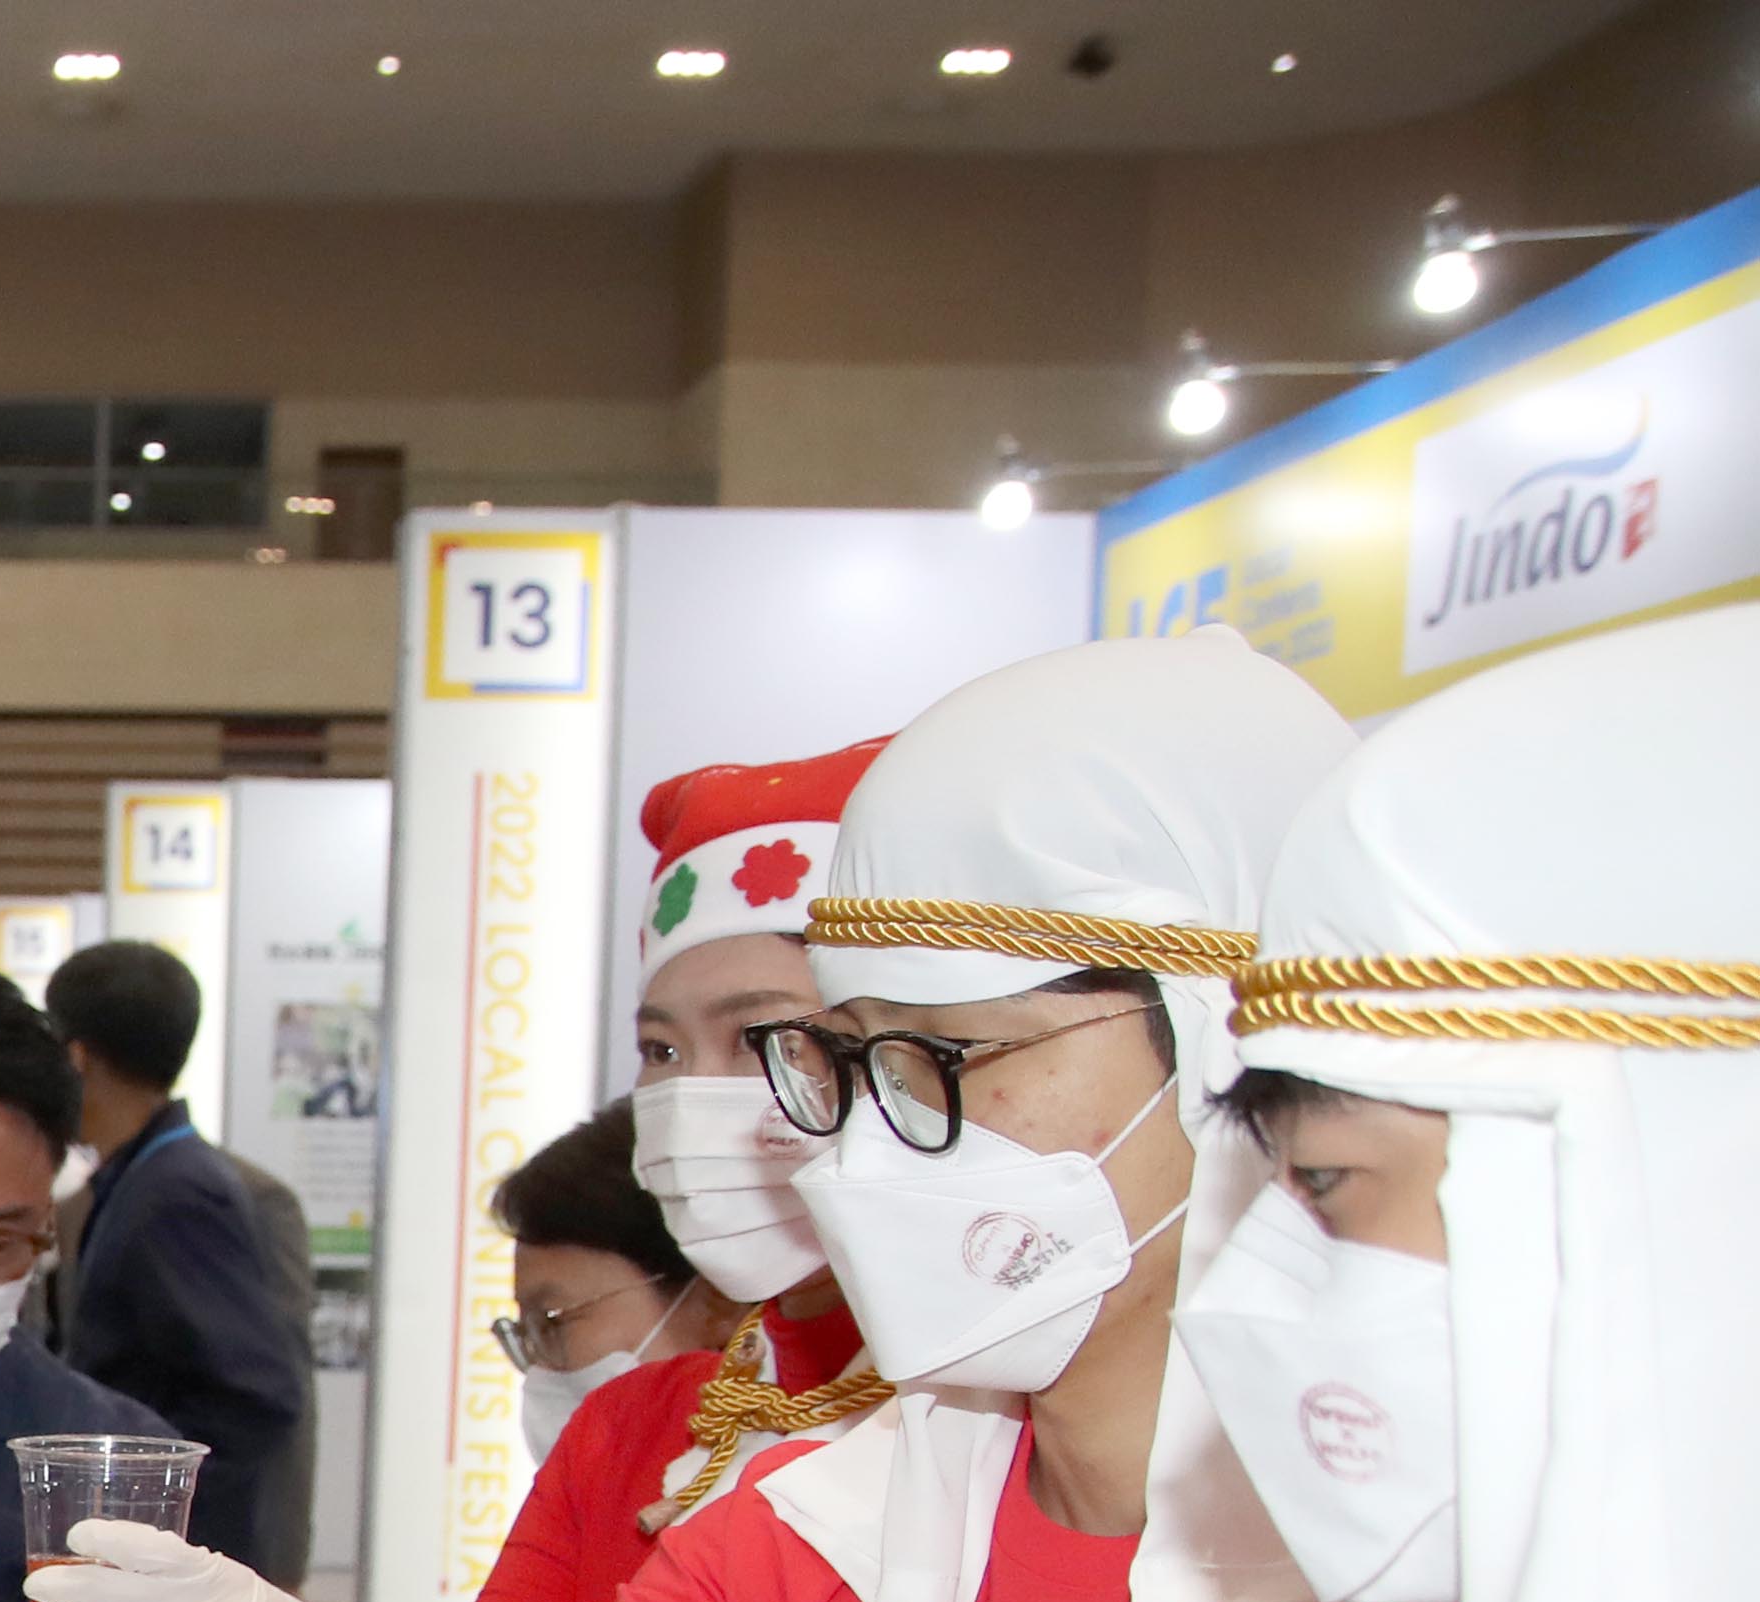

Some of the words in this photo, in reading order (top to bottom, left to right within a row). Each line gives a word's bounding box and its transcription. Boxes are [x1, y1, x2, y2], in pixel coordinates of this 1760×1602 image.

[470, 582, 553, 650] 13
[1423, 485, 1614, 628] Jindo
[145, 823, 194, 864] 14
[486, 771, 540, 903] 2022
[479, 923, 533, 1111] LOCAL
[458, 1442, 509, 1593] FESTA
